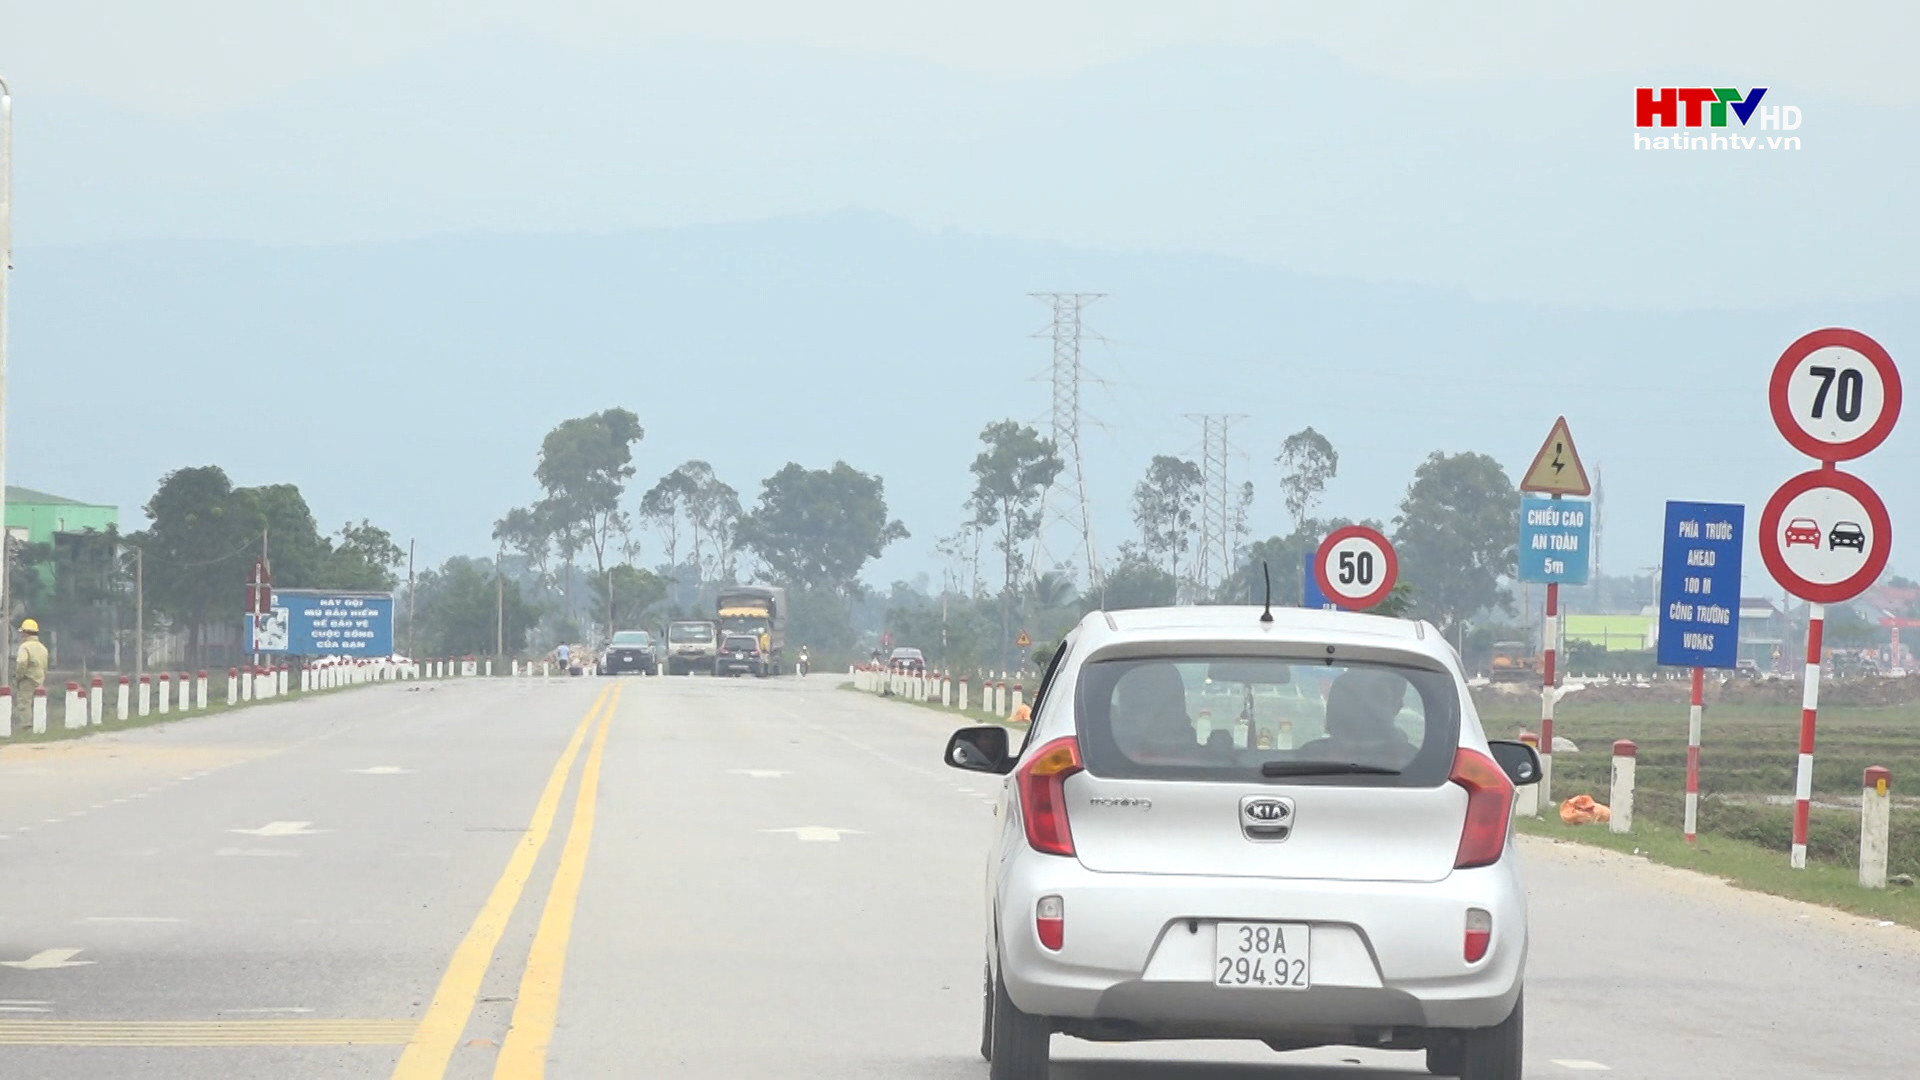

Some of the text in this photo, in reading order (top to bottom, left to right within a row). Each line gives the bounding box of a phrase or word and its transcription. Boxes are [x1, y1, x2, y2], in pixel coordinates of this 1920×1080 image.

[1810, 366, 1863, 422] 70
[1562, 511, 1583, 527] CAO
[1679, 519, 1699, 537] PHÍA
[1532, 532, 1578, 551] AN TOÀN
[1544, 557, 1563, 574] 5m
[1687, 549, 1715, 566] AHEAD
[1339, 551, 1373, 584] 50
[1684, 577, 1711, 594] 100 M
[1670, 601, 1692, 621] CÔNG
[1683, 632, 1713, 651] WORKS
[1253, 805, 1281, 818] KIA
[1239, 926, 1286, 953] 38A
[1219, 957, 1305, 986] 294.92
